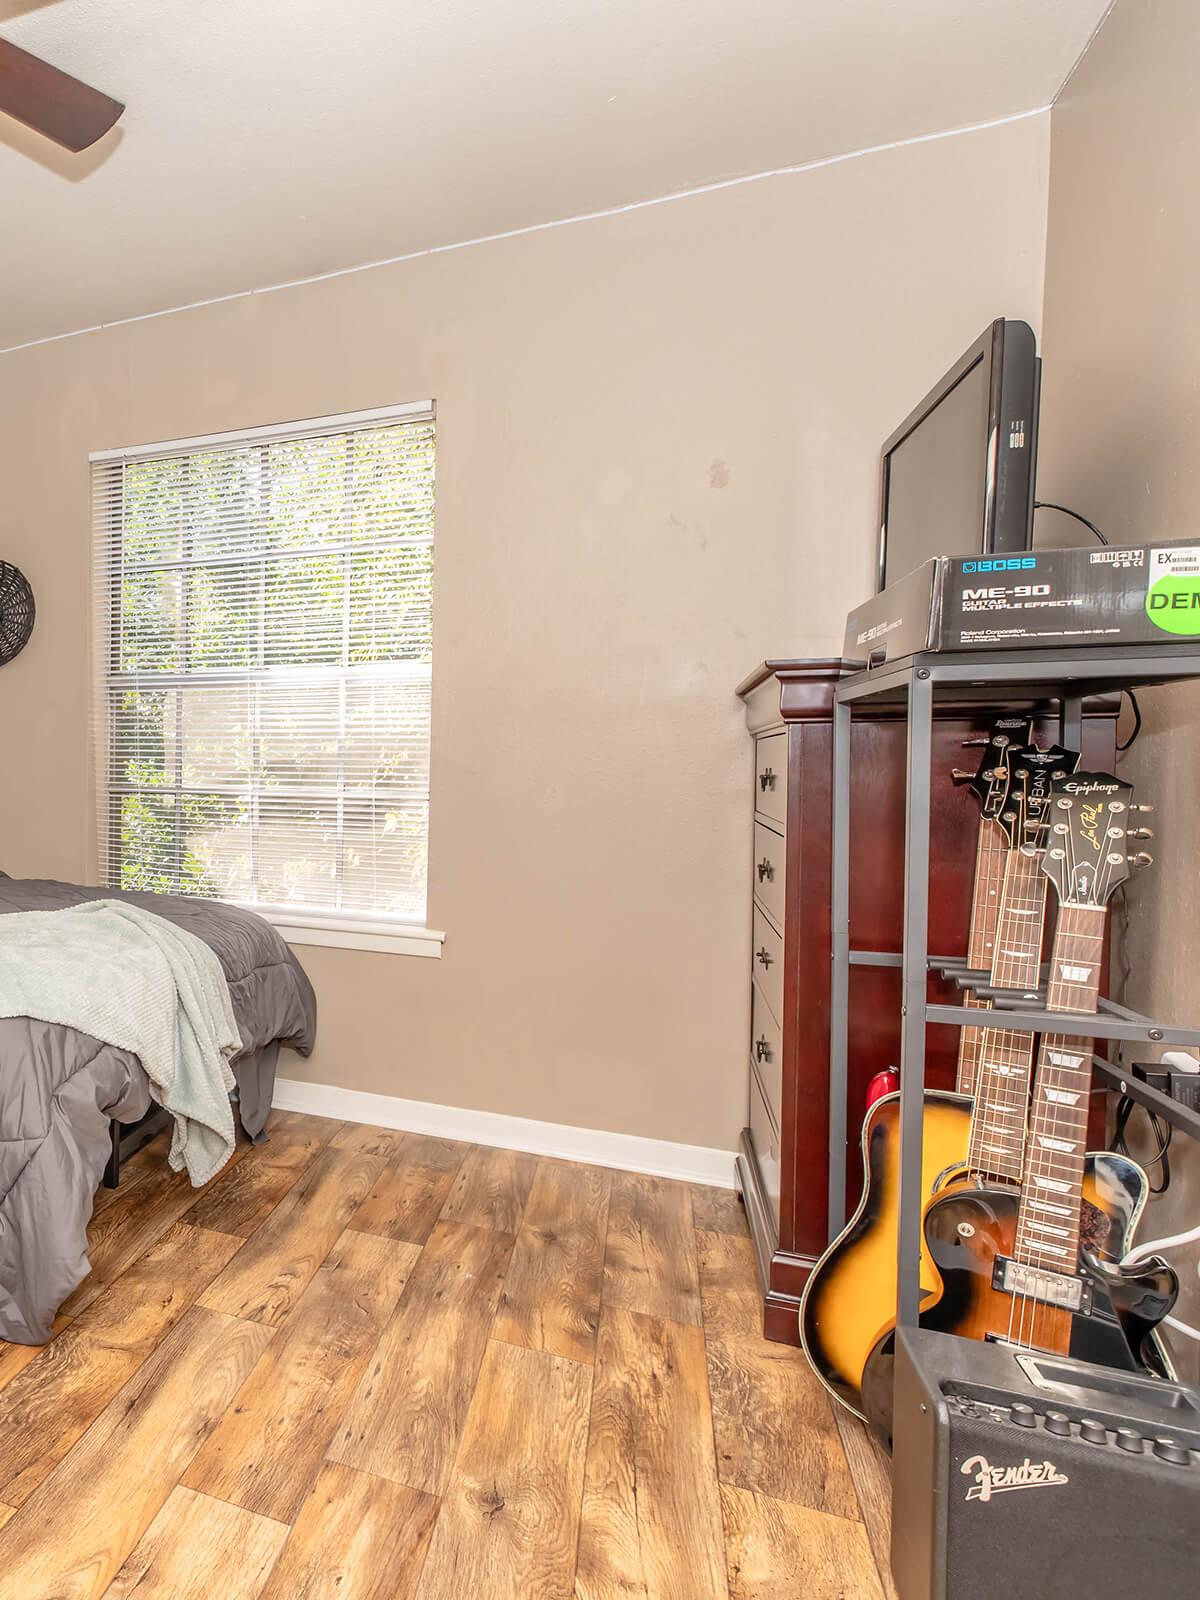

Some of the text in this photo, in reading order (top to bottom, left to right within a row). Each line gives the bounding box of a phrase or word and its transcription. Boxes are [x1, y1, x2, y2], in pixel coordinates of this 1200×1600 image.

[977, 558, 1037, 572] BOSS
[962, 584, 1051, 600] ME-90
[962, 599, 1007, 607] GUITAR
[962, 599, 1083, 612] MULTIPLE EFFECTS
[985, 628, 1026, 636] Corporation
[1062, 781, 1120, 796] Epiphone
[961, 1455, 1069, 1501] Fender
